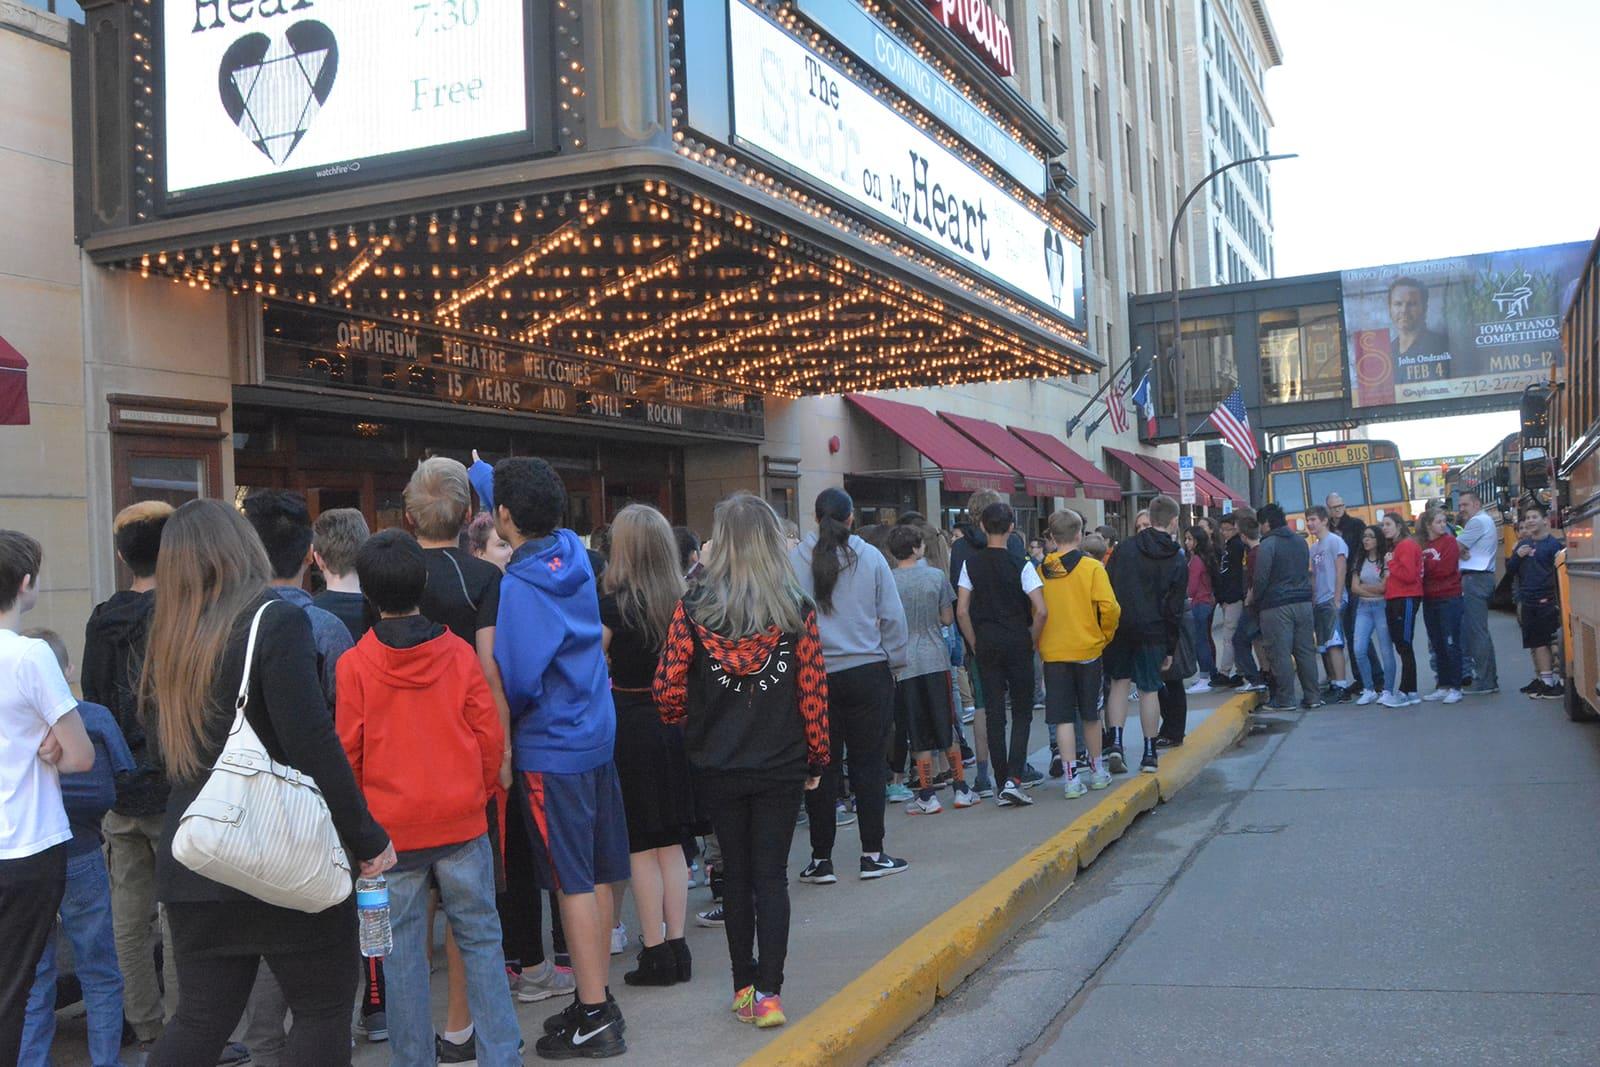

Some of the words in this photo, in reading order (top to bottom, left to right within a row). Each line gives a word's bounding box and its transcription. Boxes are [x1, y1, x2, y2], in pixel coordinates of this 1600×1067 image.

[413, 0, 480, 37] 7:30
[410, 77, 483, 112] Free
[805, 55, 840, 110] The
[875, 33, 931, 99] COMING
[934, 82, 1007, 160] ATTRACTIONS
[863, 168, 882, 202] on
[890, 174, 911, 226] My
[909, 149, 991, 261] Heart
[1475, 328, 1560, 345] COMPETITION
[1480, 322, 1512, 335] IOWA
[1515, 318, 1555, 331] PIANO
[337, 322, 418, 358] ORPHEUM
[443, 340, 506, 373] THEATRE
[523, 352, 592, 386] WELCOMES
[614, 372, 636, 393] YOU
[1398, 355, 1416, 367] John
[1407, 363, 1430, 379] FEB
[1435, 362, 1443, 377] 4
[1490, 354, 1520, 372] MAR
[448, 373, 463, 397] 15
[476, 377, 521, 405] YEARS
[543, 387, 567, 410] AND
[591, 394, 622, 418] STILL
[647, 402, 682, 425] ROCKIN
[1297, 450, 1341, 467] SCHOOL
[1347, 446, 1369, 462] BUS
